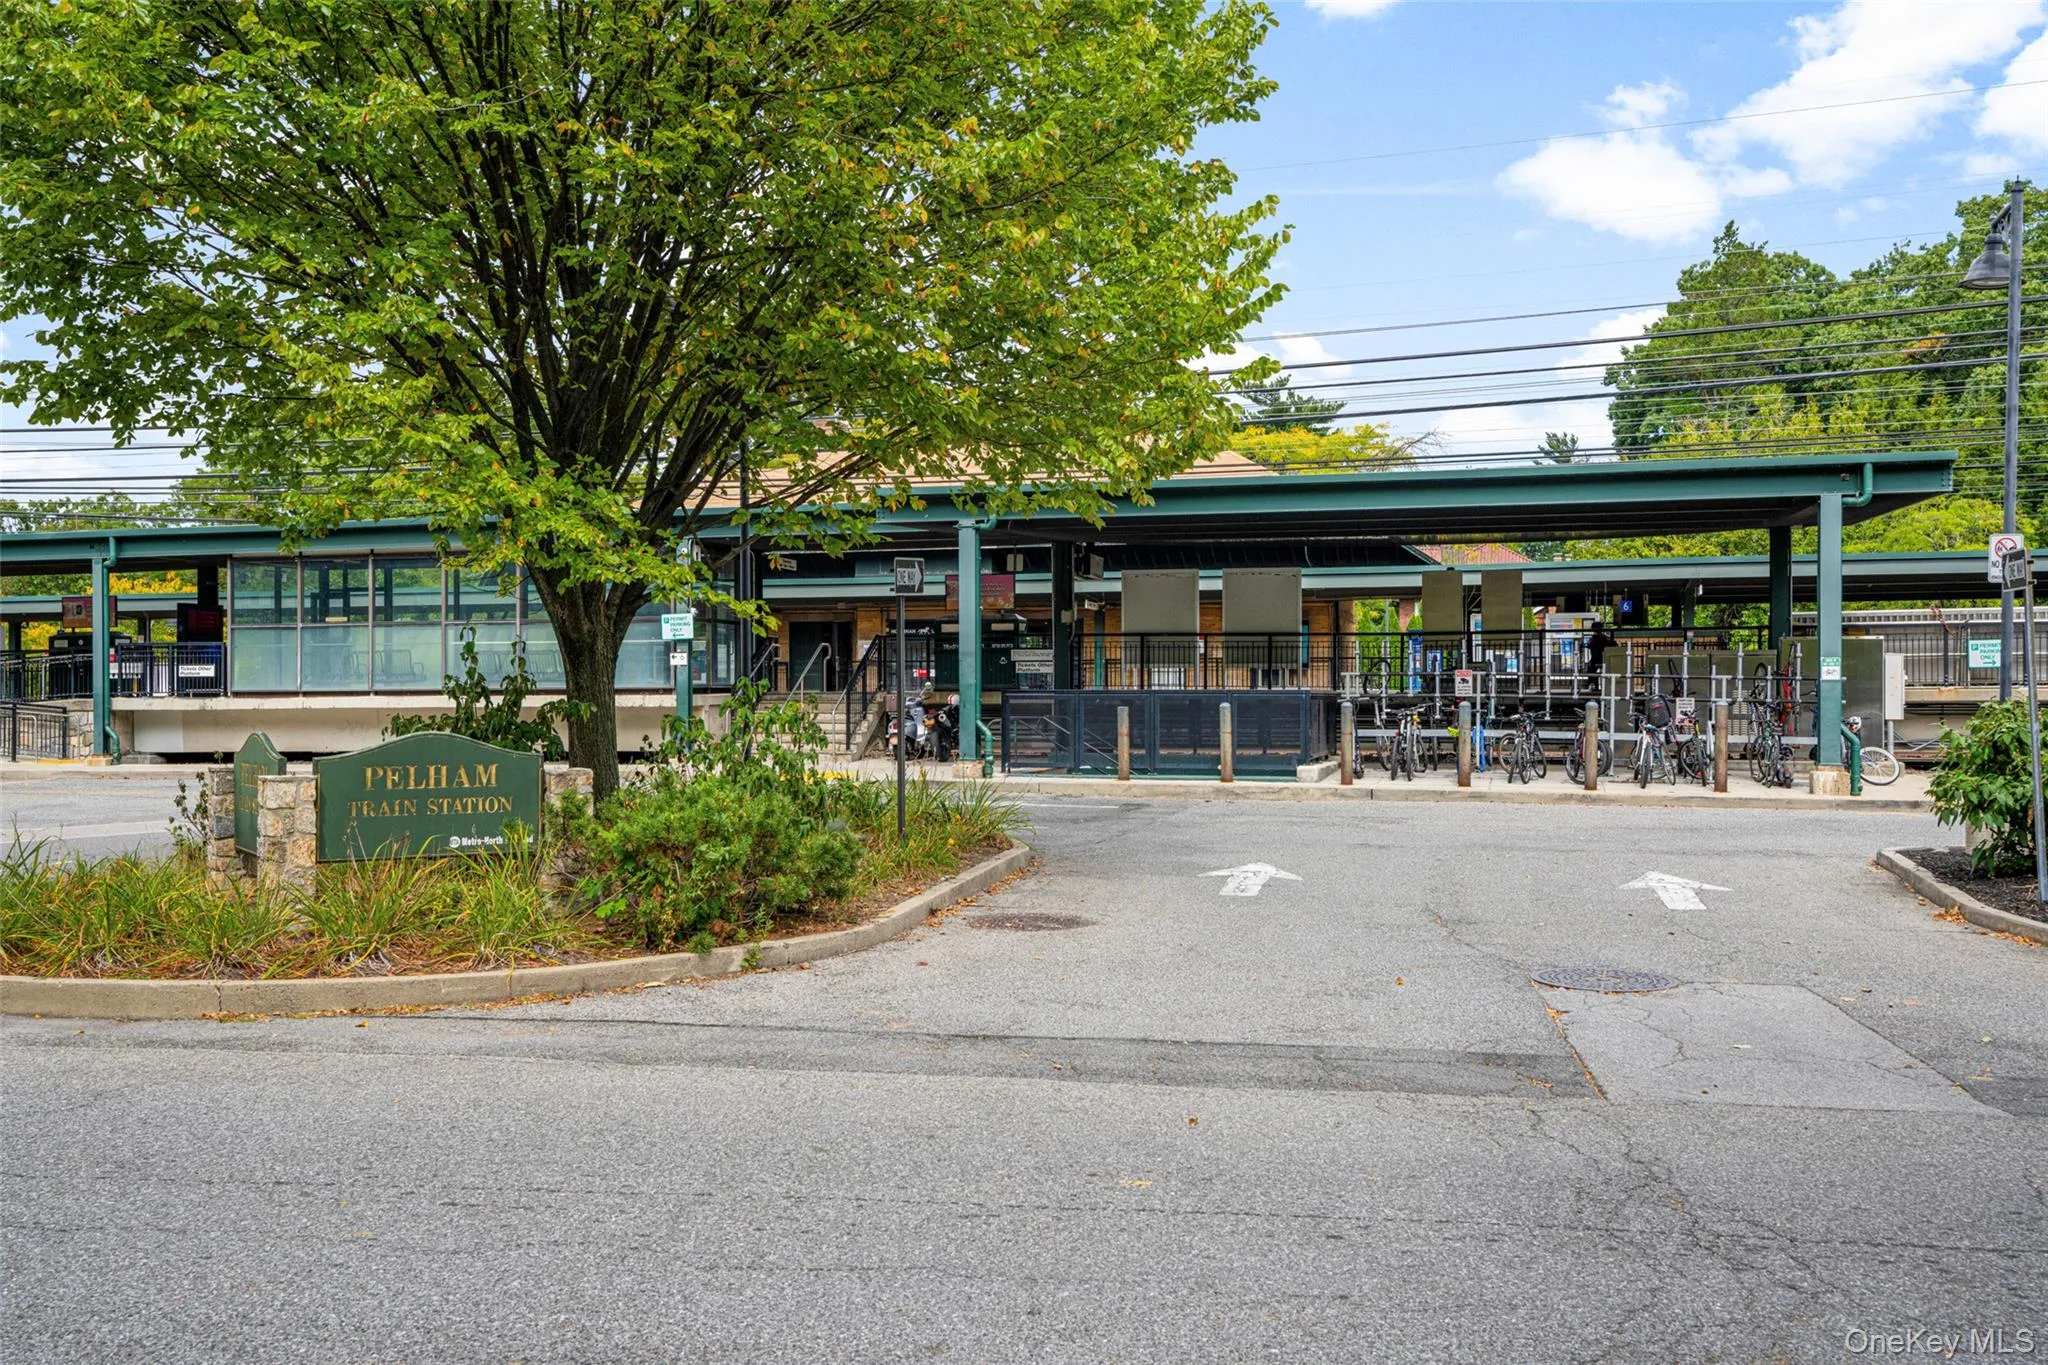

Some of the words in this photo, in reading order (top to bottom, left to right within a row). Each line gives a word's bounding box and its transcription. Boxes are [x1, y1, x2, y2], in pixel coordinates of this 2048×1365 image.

[1623, 601, 1630, 611] 6
[363, 762, 499, 791] PELHAM
[347, 798, 418, 817] TRAIN
[426, 795, 513, 815] STATION
[462, 835, 504, 846] Metro-North
